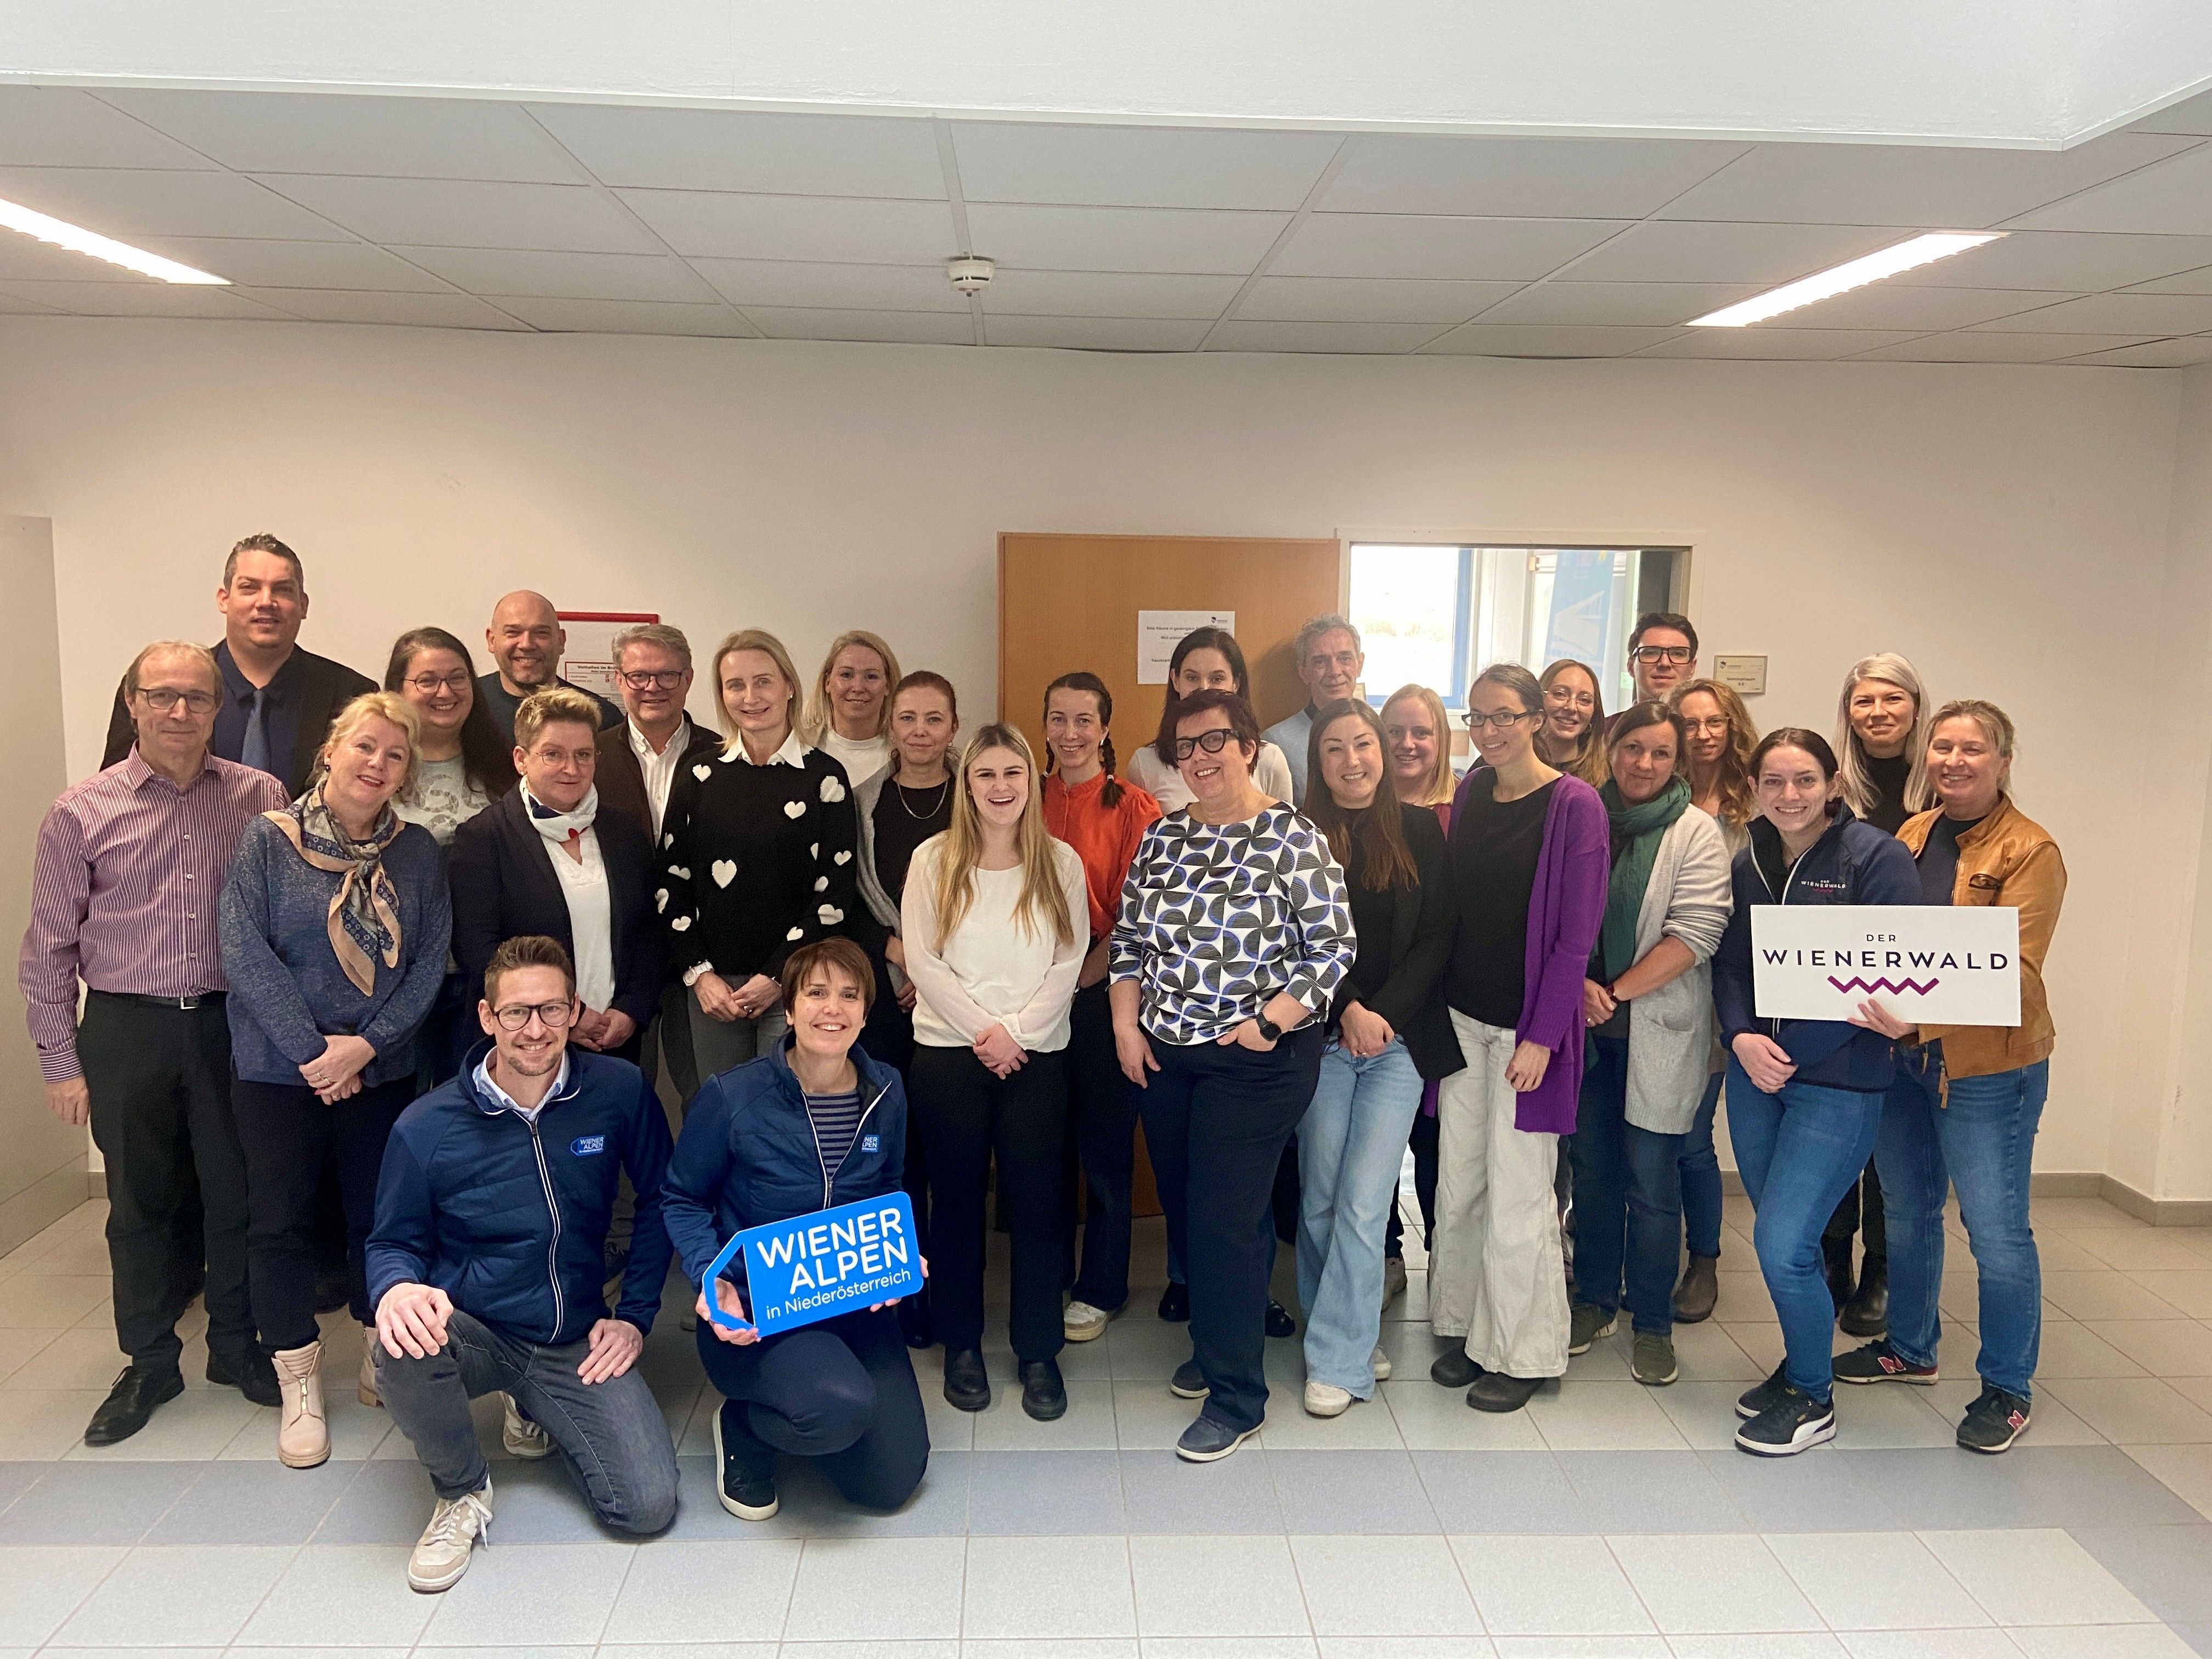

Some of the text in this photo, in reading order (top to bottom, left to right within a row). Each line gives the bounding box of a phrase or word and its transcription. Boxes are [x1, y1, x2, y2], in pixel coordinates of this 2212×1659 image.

[1866, 934, 1897, 942] DER
[1762, 949, 2008, 969] WIENERWALD
[580, 1137, 604, 1145] WIENER
[757, 1207, 903, 1268] WIENER
[789, 1236, 909, 1295] ALPEN
[766, 1268, 911, 1320] in Niederösterreich
